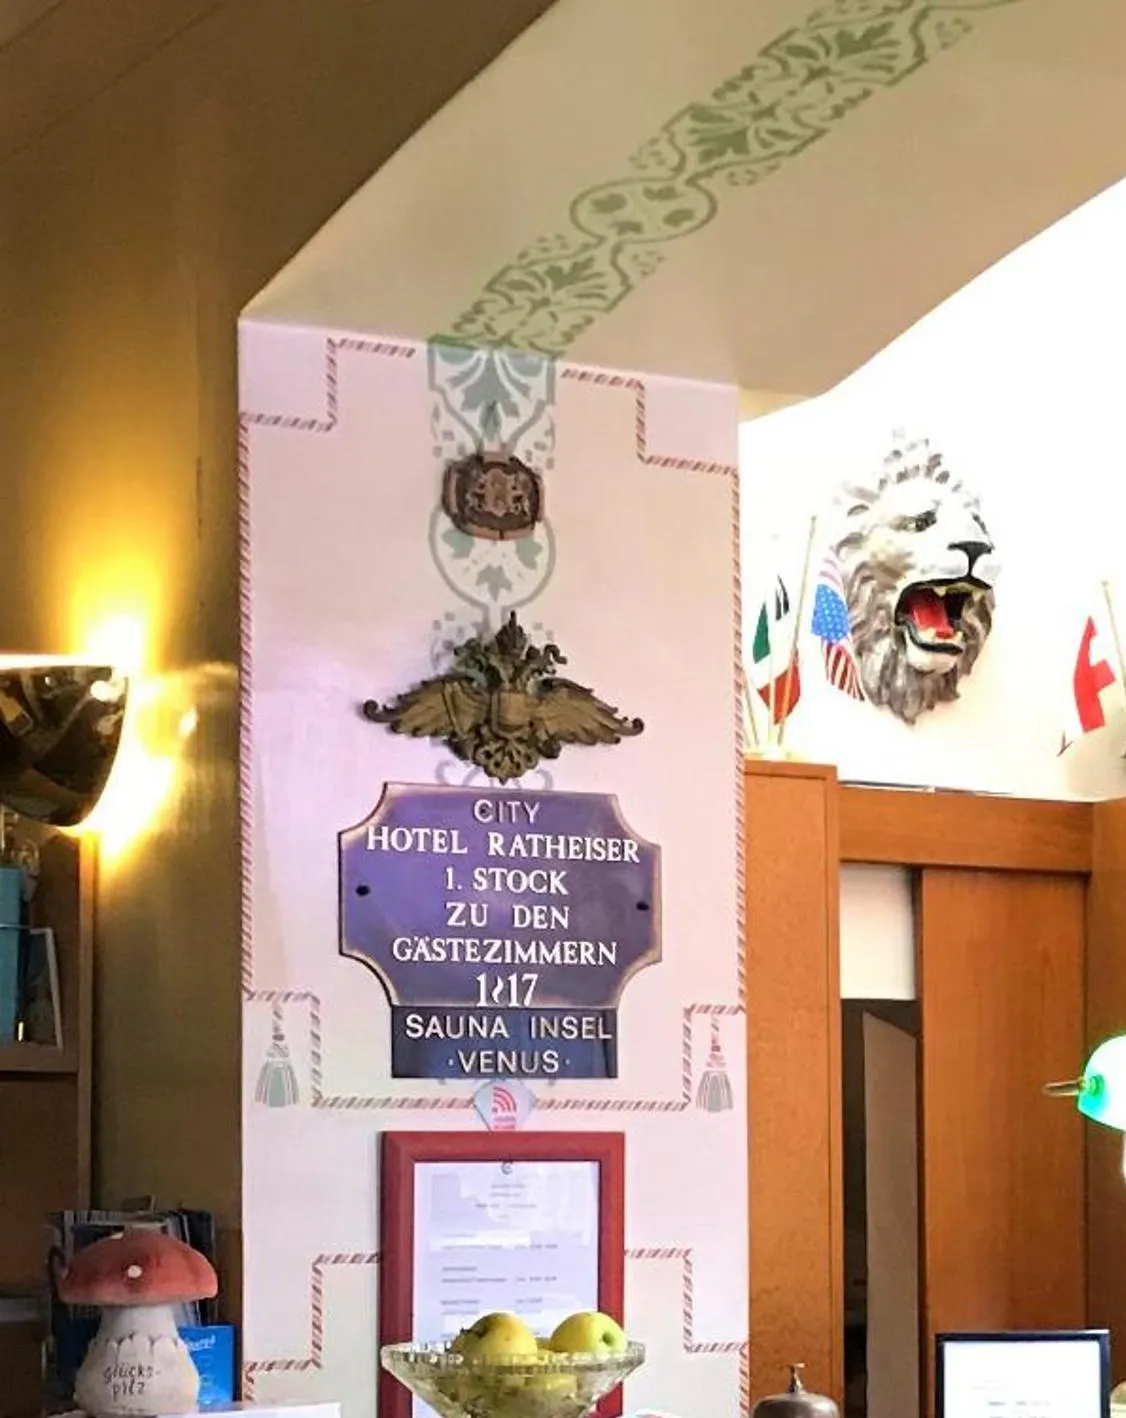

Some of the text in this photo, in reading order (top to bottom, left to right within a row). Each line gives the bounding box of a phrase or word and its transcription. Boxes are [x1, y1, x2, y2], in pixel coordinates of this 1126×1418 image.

[474, 799, 540, 824] CITY
[366, 826, 641, 863] HOTEL RATHEISER
[446, 867, 569, 895] 1. STOCK
[445, 902, 570, 929] ZU DEN
[392, 935, 617, 966] GÄSTEZIMMERN
[405, 1013, 613, 1040] SAUNA INSEL
